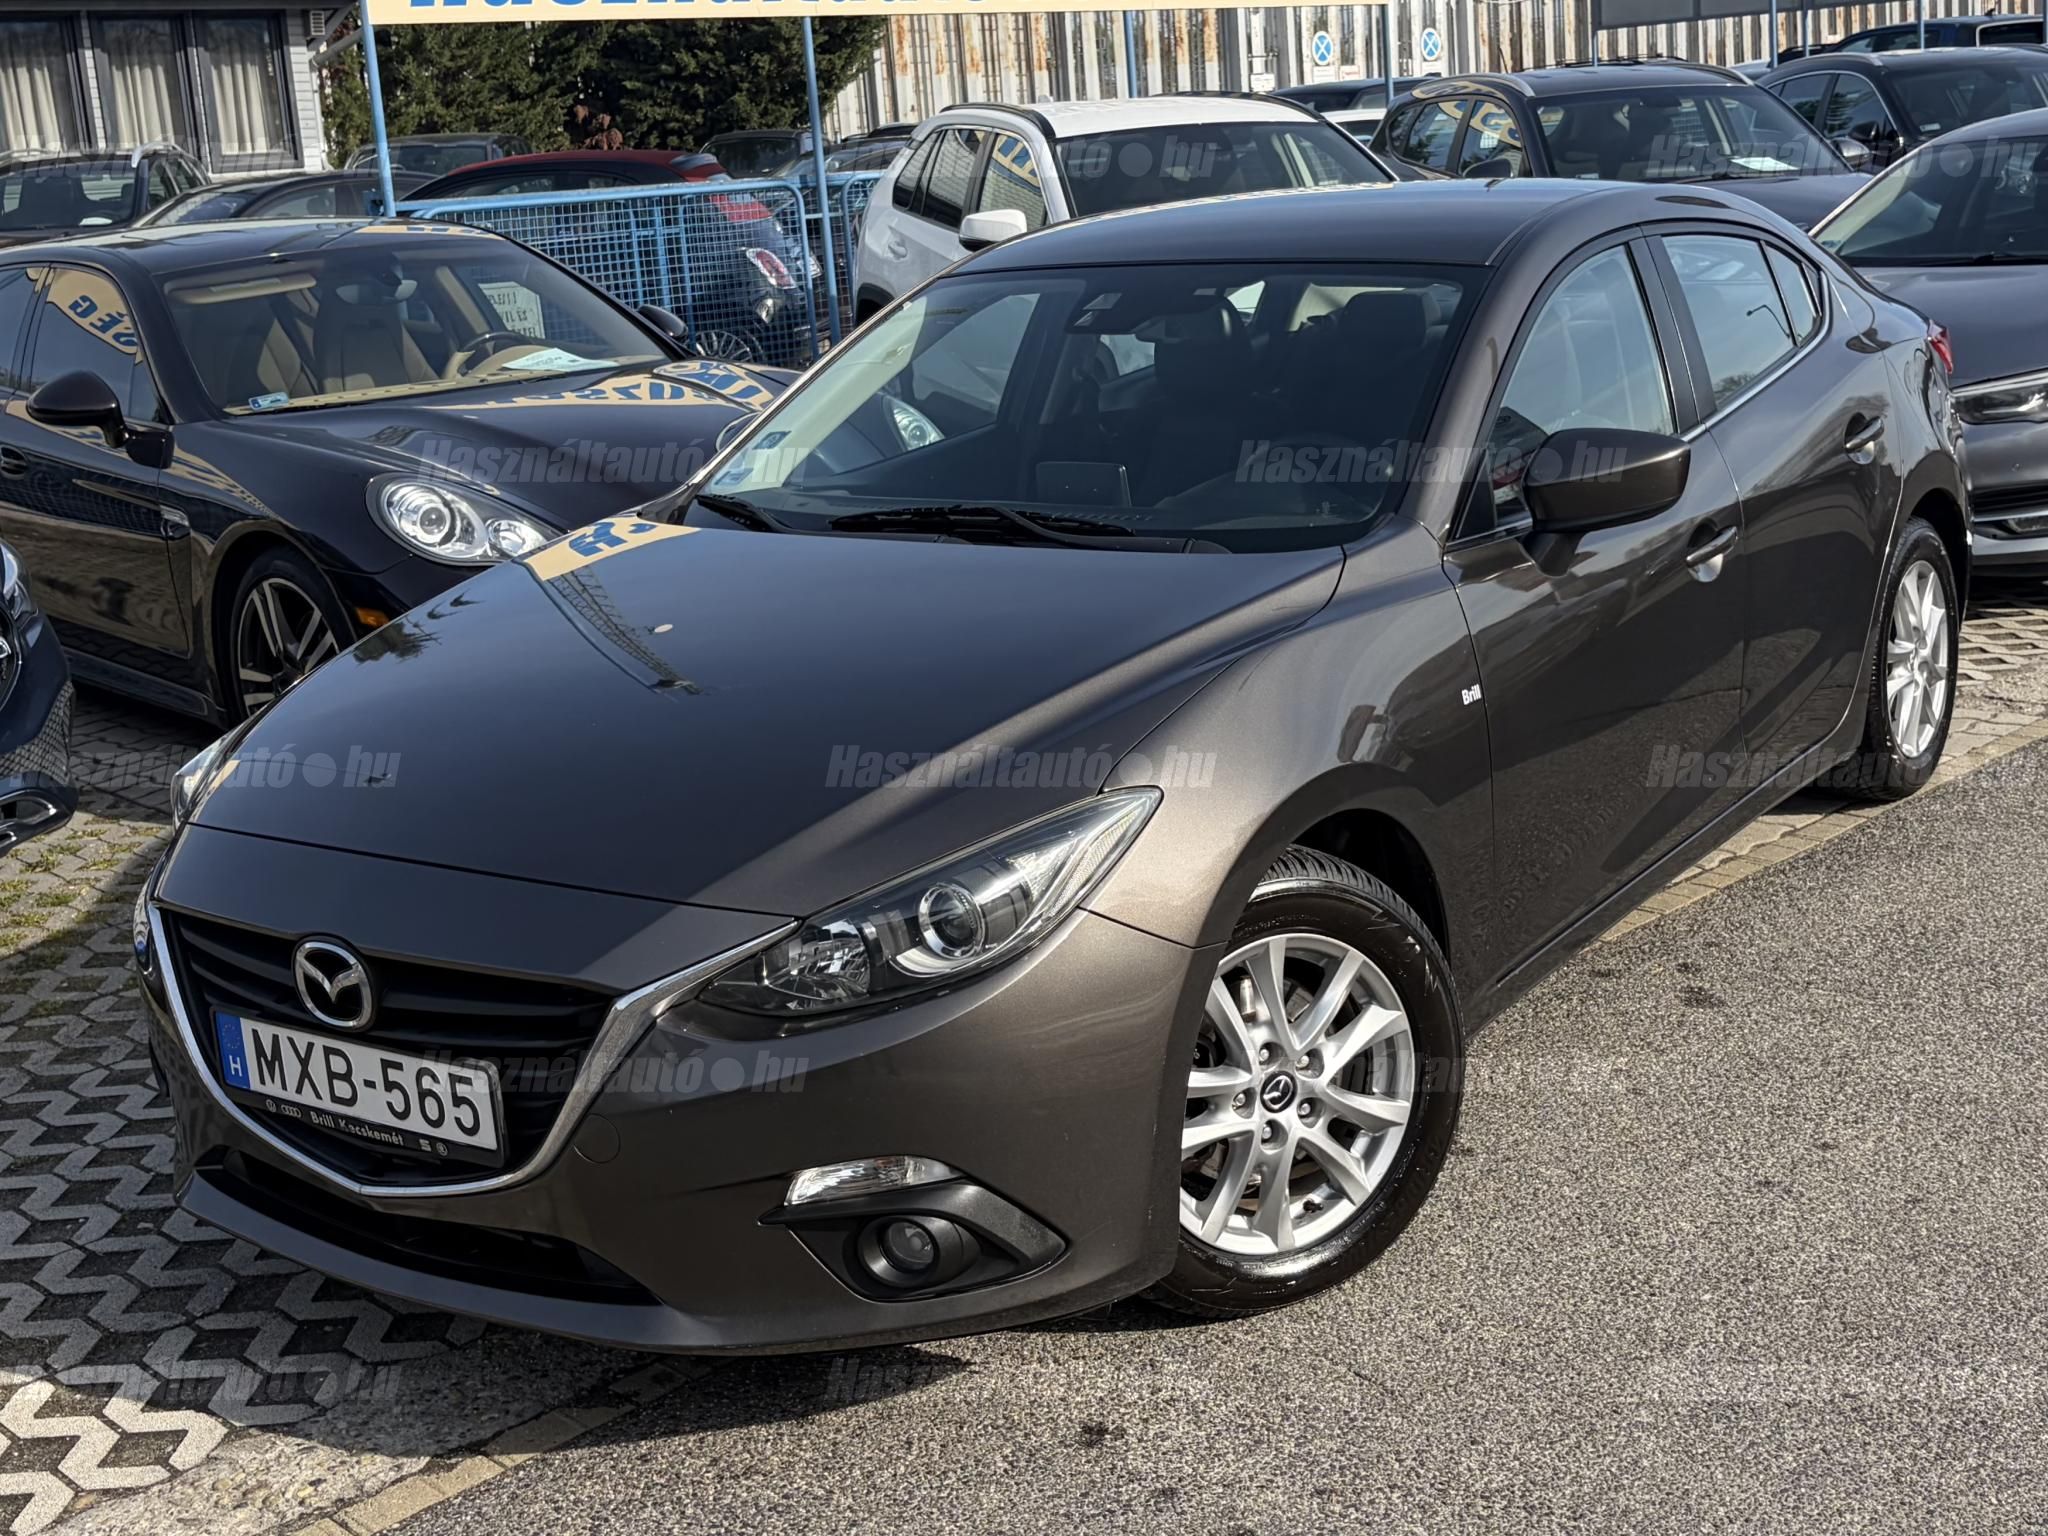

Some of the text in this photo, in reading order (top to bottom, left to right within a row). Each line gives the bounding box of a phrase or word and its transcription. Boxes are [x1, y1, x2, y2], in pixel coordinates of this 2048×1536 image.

[1461, 684, 1482, 706] Brill
[229, 1055, 243, 1078] H
[251, 1028, 481, 1137] MXB-565
[310, 1110, 335, 1129] Brill
